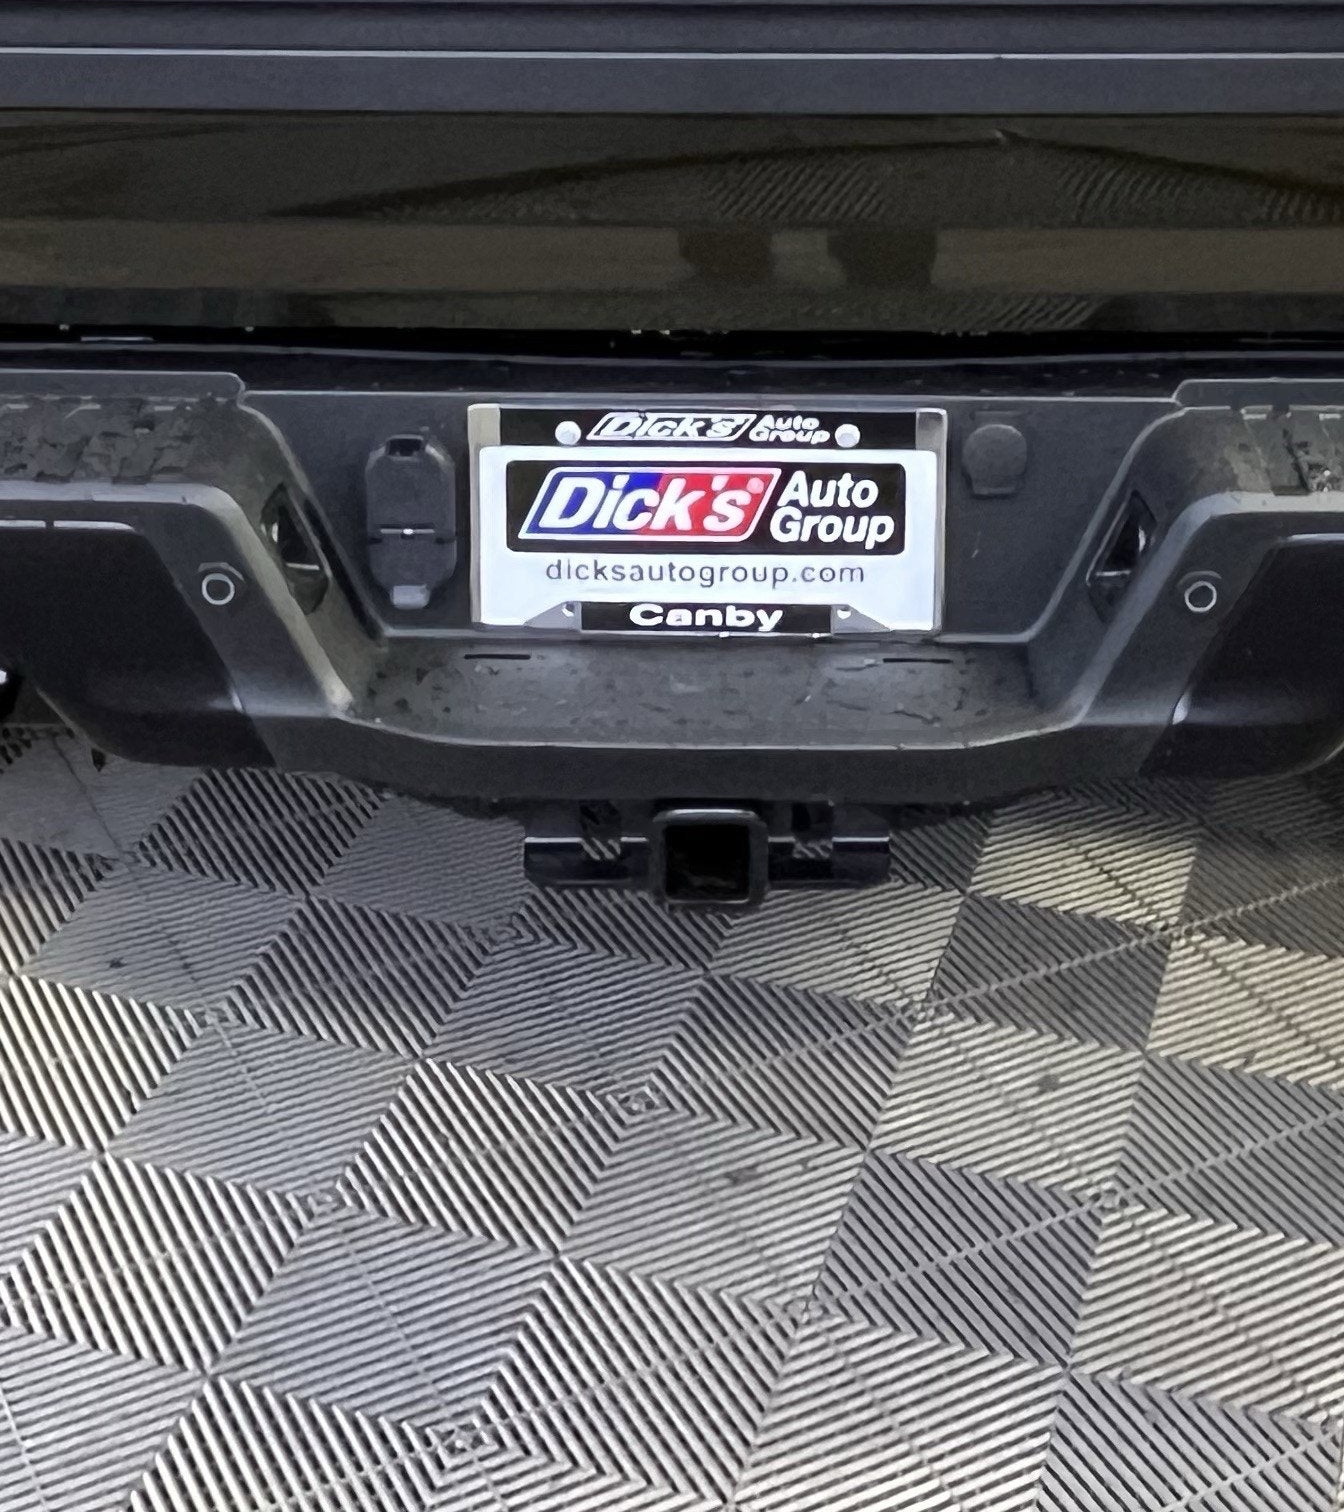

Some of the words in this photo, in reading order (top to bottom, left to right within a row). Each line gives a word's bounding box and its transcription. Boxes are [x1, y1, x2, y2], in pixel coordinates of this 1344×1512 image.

[762, 414, 820, 430] Auto
[749, 428, 831, 445] Group
[539, 474, 765, 531] Dick's
[777, 470, 879, 508] Auto
[769, 507, 895, 549] Group
[545, 559, 865, 588] dicksautogroup.com
[628, 603, 784, 631] Canby
